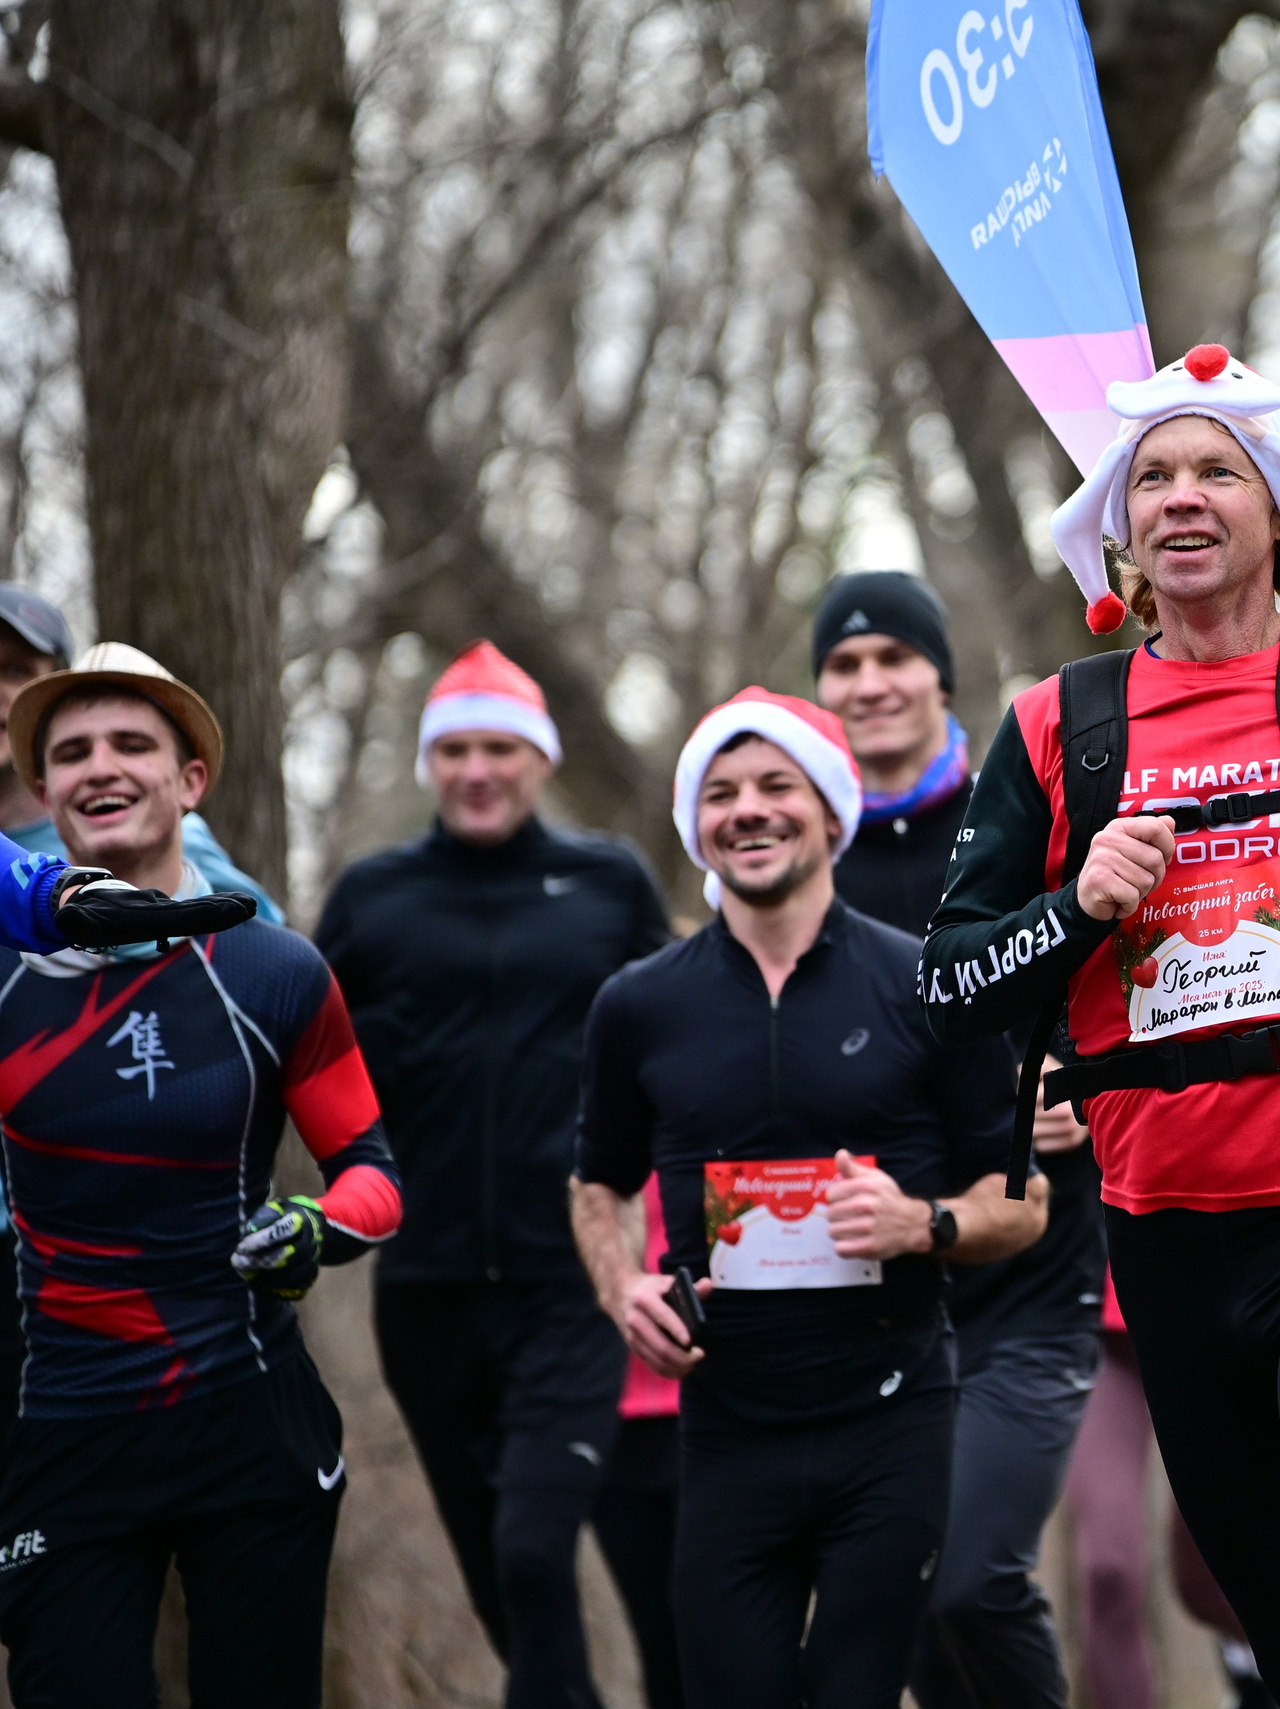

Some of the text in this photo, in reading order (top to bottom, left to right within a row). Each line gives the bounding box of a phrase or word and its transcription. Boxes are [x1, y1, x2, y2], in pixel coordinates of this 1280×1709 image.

[1119, 768, 1158, 797] LF
[1182, 877, 1234, 893] ВЫСШАЯ ЛИГА
[1143, 882, 1275, 923] Новогодний забег
[1199, 929, 1210, 938] 25
[1163, 950, 1267, 993] Георгий
[1147, 999, 1219, 1031] Марафон
[106, 1010, 175, 1101] 隼
